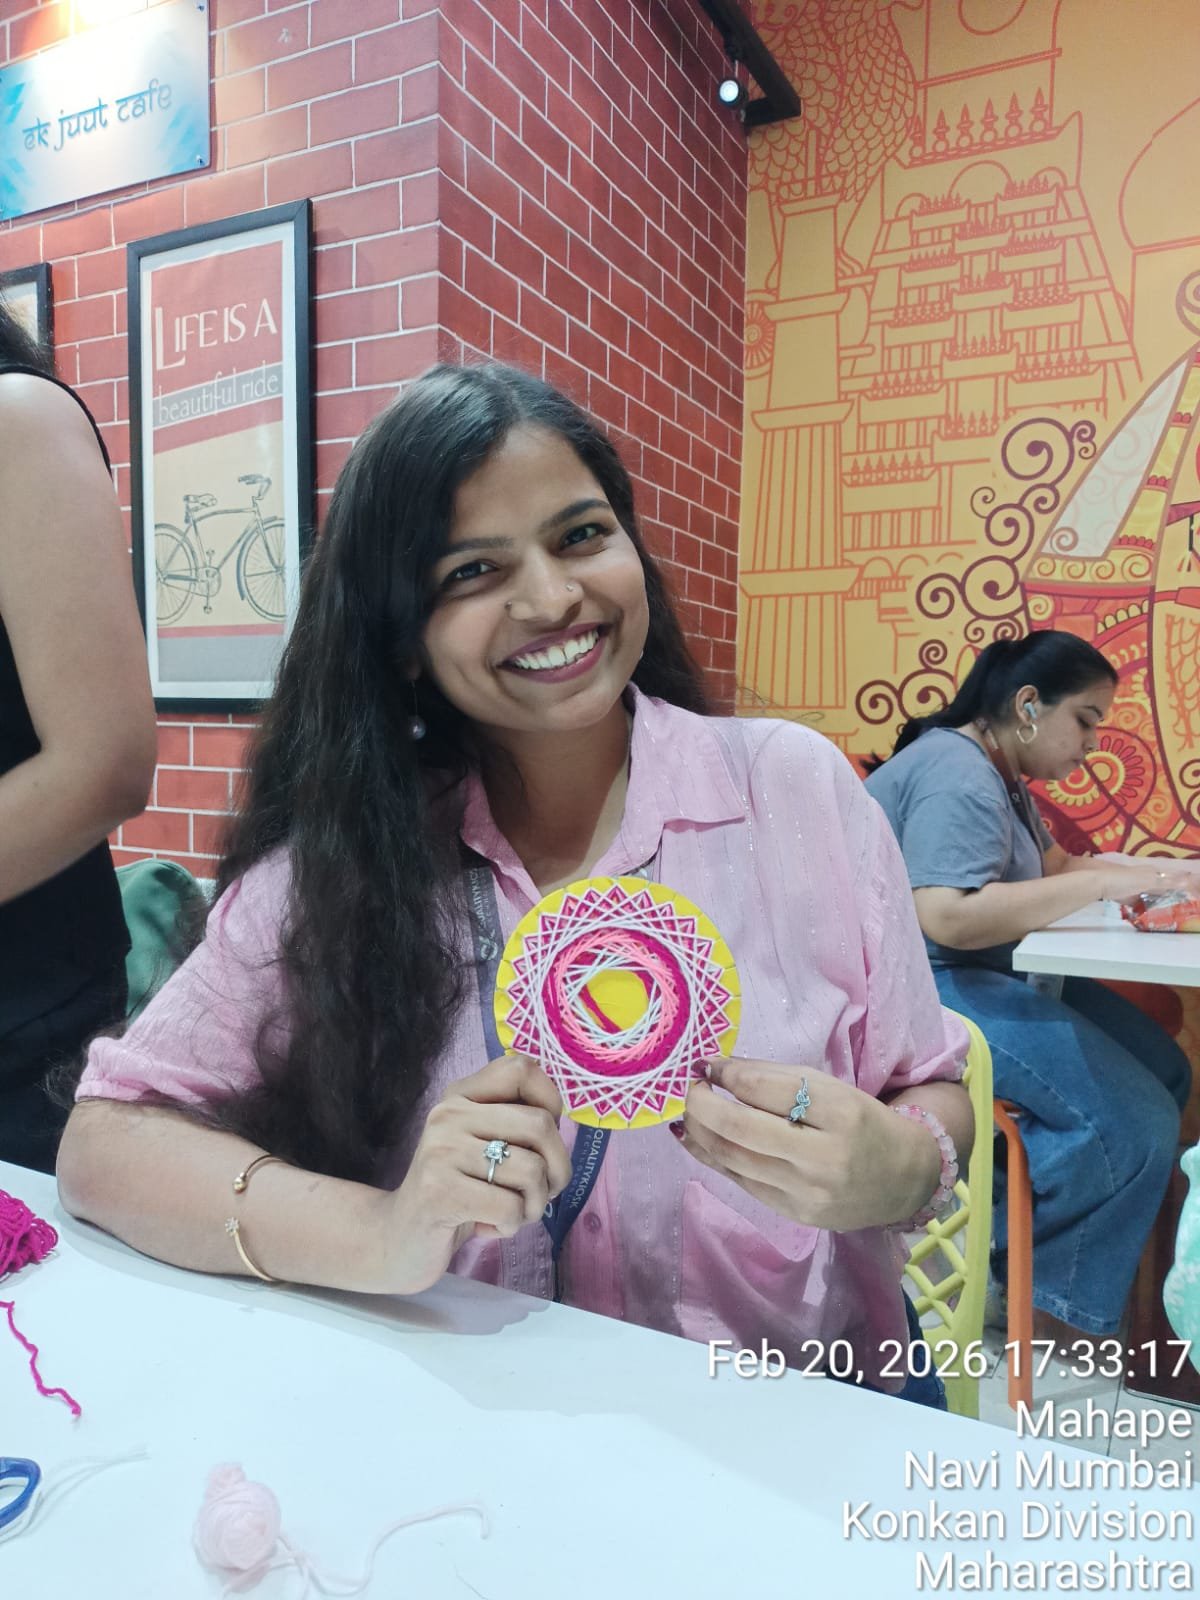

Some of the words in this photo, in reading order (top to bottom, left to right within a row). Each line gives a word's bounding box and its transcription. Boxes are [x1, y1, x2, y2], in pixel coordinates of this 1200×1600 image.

[22, 118, 50, 150] ek
[54, 97, 108, 150] juut
[116, 78, 173, 122] cafe
[155, 307, 218, 370] LIFE
[223, 303, 247, 344] IS
[254, 298, 277, 337] A
[158, 367, 237, 424] beautiful
[242, 359, 279, 398] ride
[569, 1129, 604, 1208] QUALITYKIOSK
